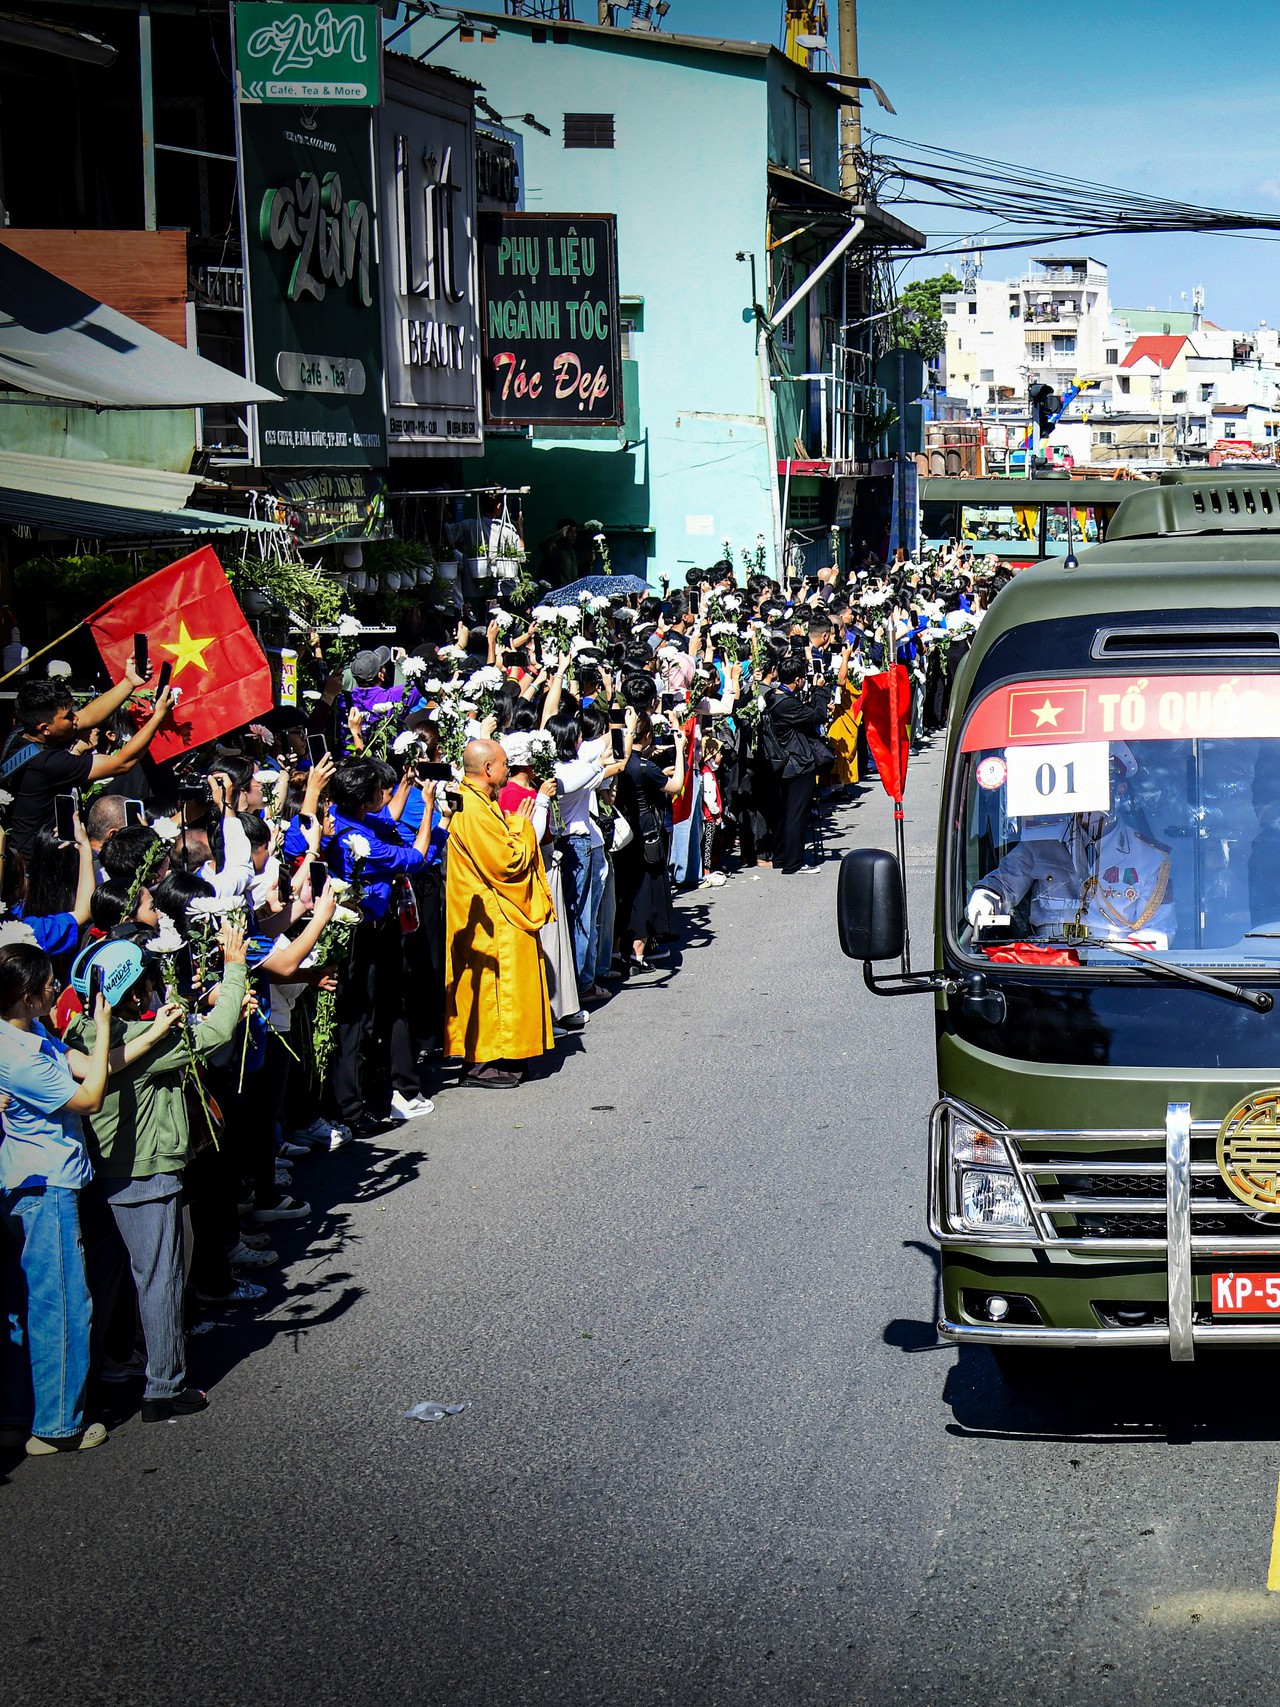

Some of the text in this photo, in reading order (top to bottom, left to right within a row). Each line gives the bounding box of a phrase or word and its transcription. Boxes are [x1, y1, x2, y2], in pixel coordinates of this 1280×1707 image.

[270, 85, 361, 95] Café, Tea & More
[498, 226, 596, 284] PHỤ LIỆU
[489, 290, 608, 340] NGÀNH TÓC
[402, 318, 465, 370] BEAUTY
[300, 362, 322, 385] Café
[330, 365, 345, 387] Tea
[493, 352, 609, 411] Tóc Đẹp
[1099, 678, 1149, 732] TỔ
[1035, 761, 1078, 796] 01
[104, 959, 133, 993] WANDER
